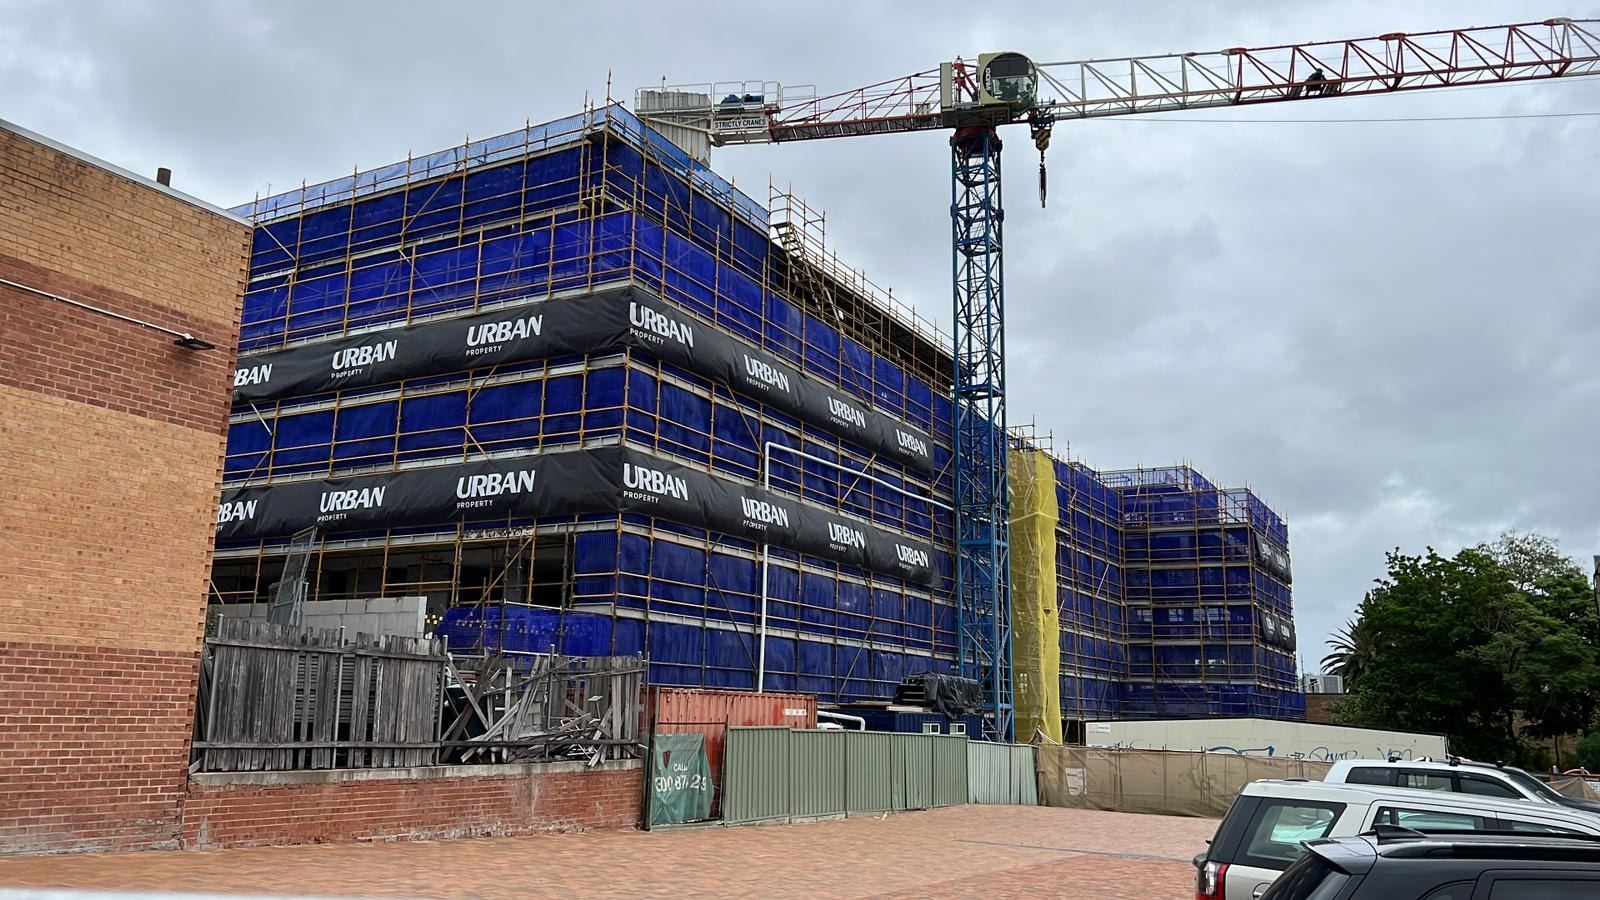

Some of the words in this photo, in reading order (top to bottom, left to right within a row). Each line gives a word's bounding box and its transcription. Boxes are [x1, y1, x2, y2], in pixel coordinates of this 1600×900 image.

[714, 120, 742, 129] STRICTLY
[742, 118, 767, 127] CRANES
[466, 314, 543, 347] URBAN
[629, 301, 694, 348] URBAN
[629, 327, 665, 346] PROPERTY
[332, 339, 398, 370] URBAN
[465, 345, 503, 357] PROPERTY
[331, 368, 363, 380] PROPERTY
[744, 354, 790, 393] URBAN
[746, 376, 770, 392] PROPERTY
[827, 395, 866, 429] URBAN
[895, 429, 928, 458] URBAN
[456, 469, 536, 499] URBAN
[622, 462, 689, 501] URBAN
[319, 485, 386, 513] URBAN
[456, 499, 494, 509] PROPERTY
[623, 490, 660, 504] PROPERTY
[317, 513, 347, 523] PROPERTY
[741, 496, 789, 529] URBAN
[827, 521, 866, 550] URBAN
[895, 543, 929, 569] URBAN
